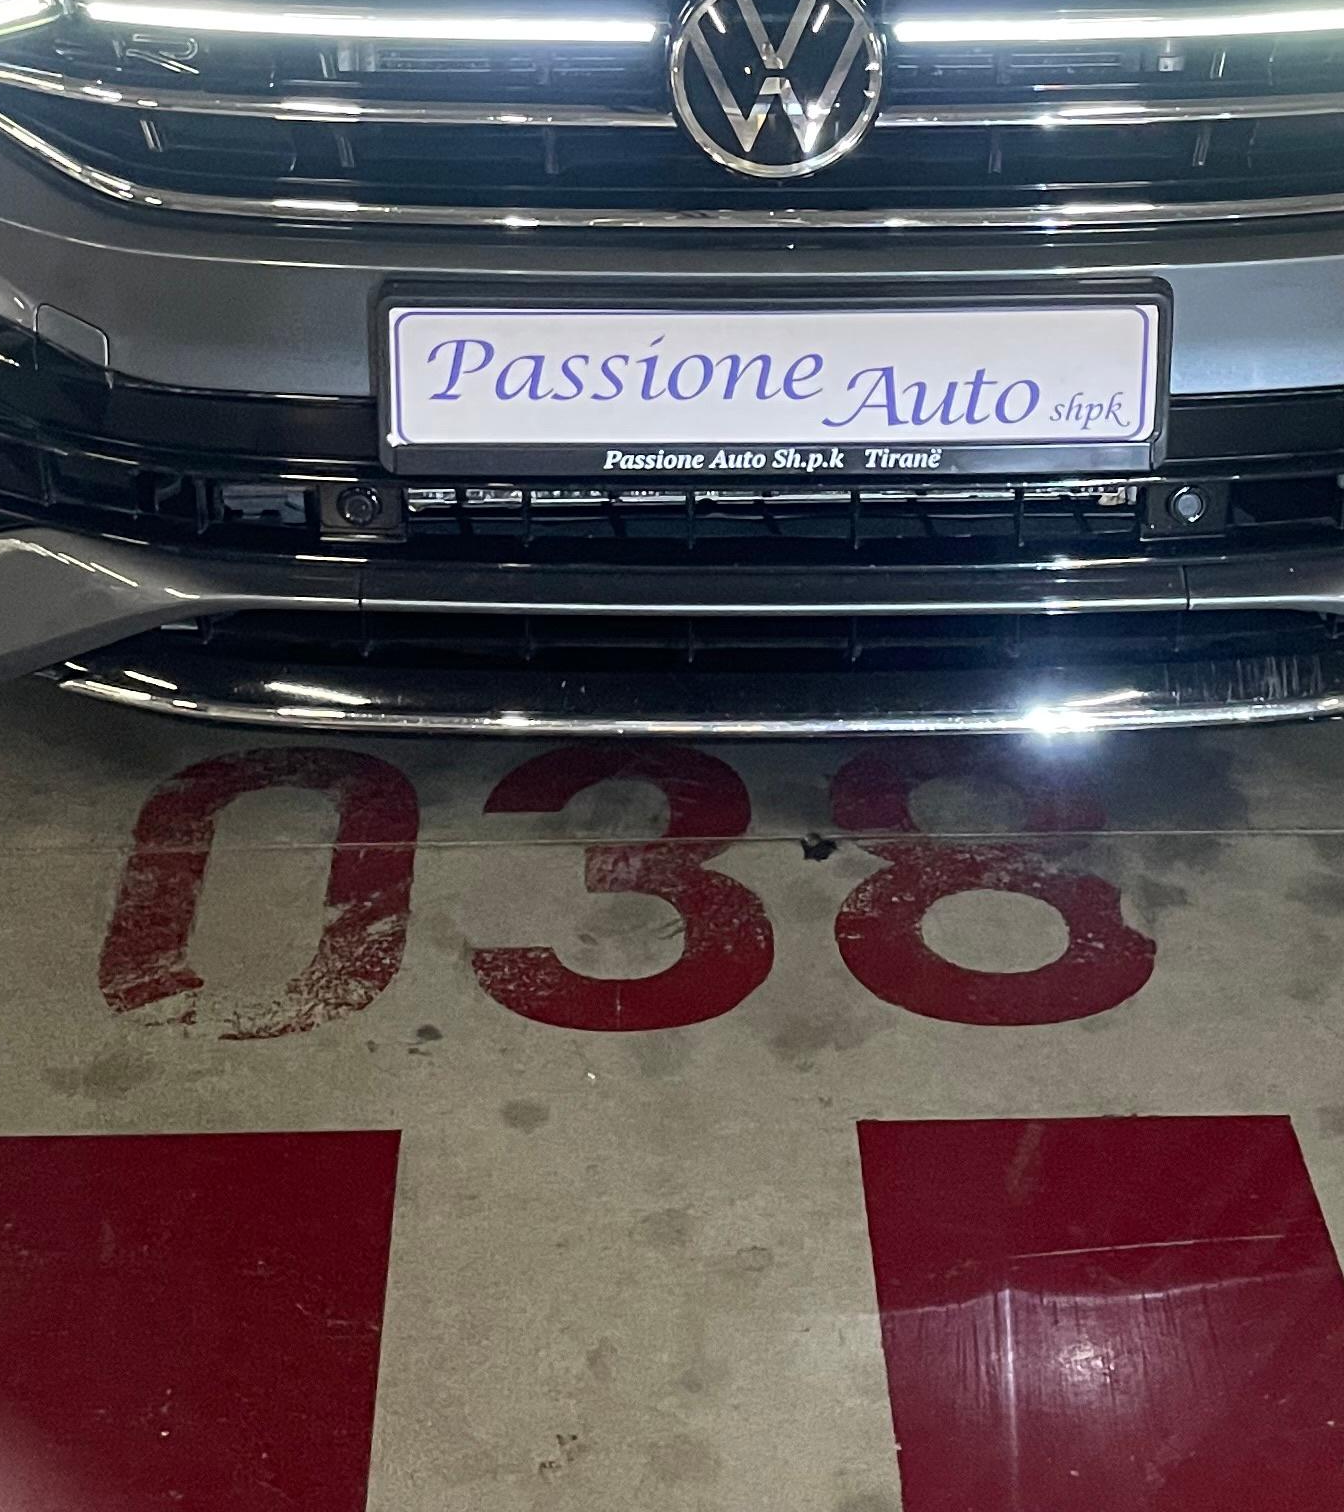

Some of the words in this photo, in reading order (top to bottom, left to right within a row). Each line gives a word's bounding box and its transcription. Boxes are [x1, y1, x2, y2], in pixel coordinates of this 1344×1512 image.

[426, 333, 825, 404] Passione
[820, 364, 1042, 428] Auto
[1048, 390, 1134, 428] shpk
[603, 450, 705, 471] Passione
[708, 449, 767, 470] Auto
[772, 447, 845, 473] Sh.p.k
[864, 447, 943, 469] Tiranë
[97, 743, 1159, 1042] 038
